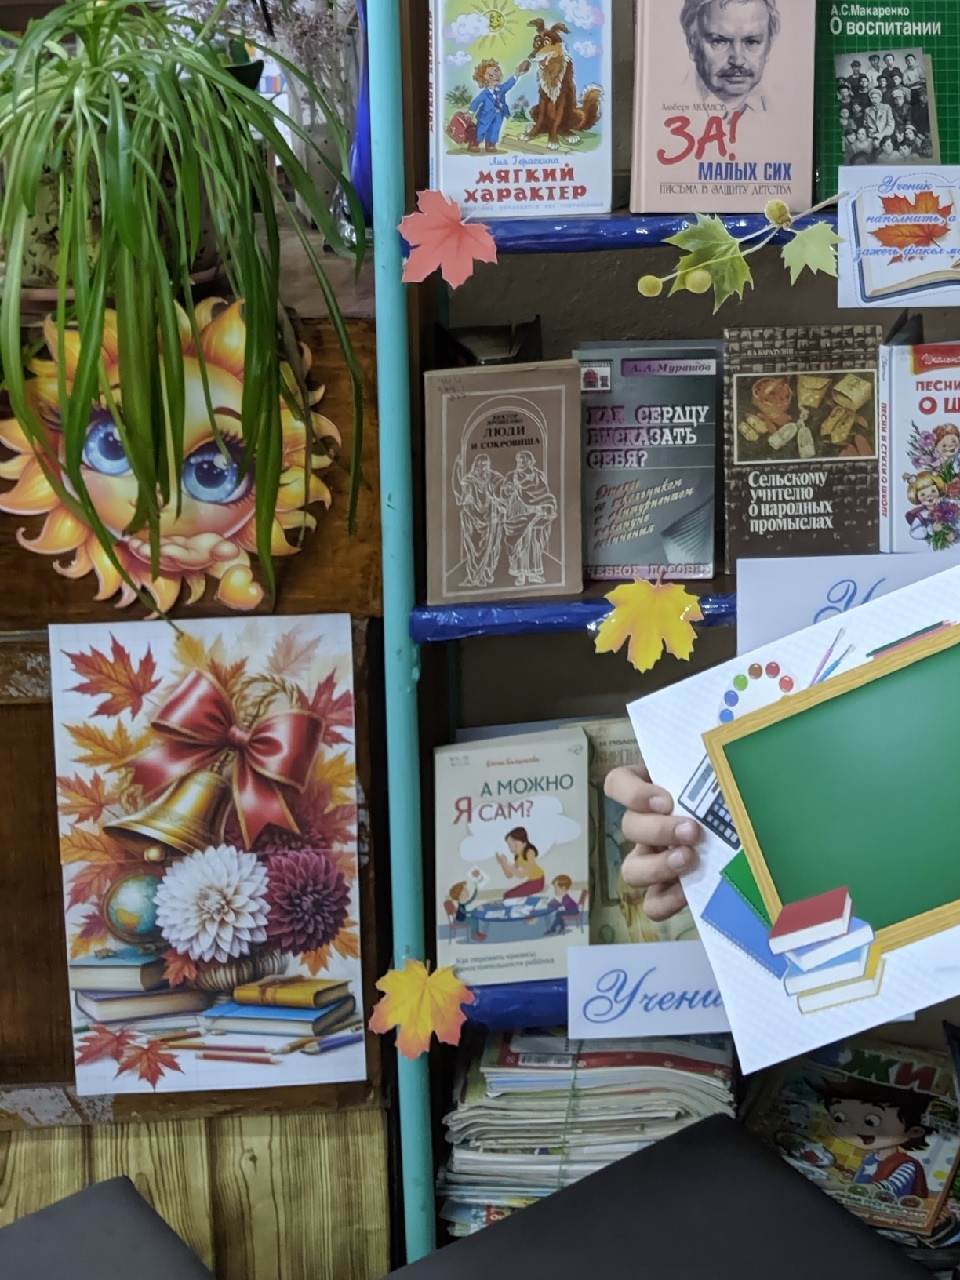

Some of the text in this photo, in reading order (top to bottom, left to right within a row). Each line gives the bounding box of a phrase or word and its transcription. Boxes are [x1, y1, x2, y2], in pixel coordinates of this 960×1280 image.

[830, 16, 941, 36] О воспитании
[657, 111, 740, 165] ЗА!
[512, 155, 559, 167] Гераскина
[698, 162, 792, 180] МАЛЫХ СИХ
[660, 184, 792, 195] ПИСЬМА В ЗАЩИТУ ДЕТСТВА
[877, 175, 932, 193] Ученик
[866, 214, 945, 225] наполнить,
[854, 248, 899, 262] зажечь
[903, 246, 945, 259] факел
[918, 396, 937, 415] О
[587, 405, 709, 427] КАК СЕРДЦУ
[483, 425, 525, 438] ЛЮДИ
[588, 427, 697, 446] ВЫСКАЗАТЬ
[471, 438, 540, 450] И СОКРОВИЩА
[588, 449, 648, 468] СЕБЯ?
[748, 470, 828, 487] Сельскому
[750, 487, 813, 503] учителю
[748, 500, 833, 517] о народных
[750, 515, 834, 535] промыслах
[481, 773, 574, 797] А МОЖНО
[453, 797, 534, 824] Я САМ?
